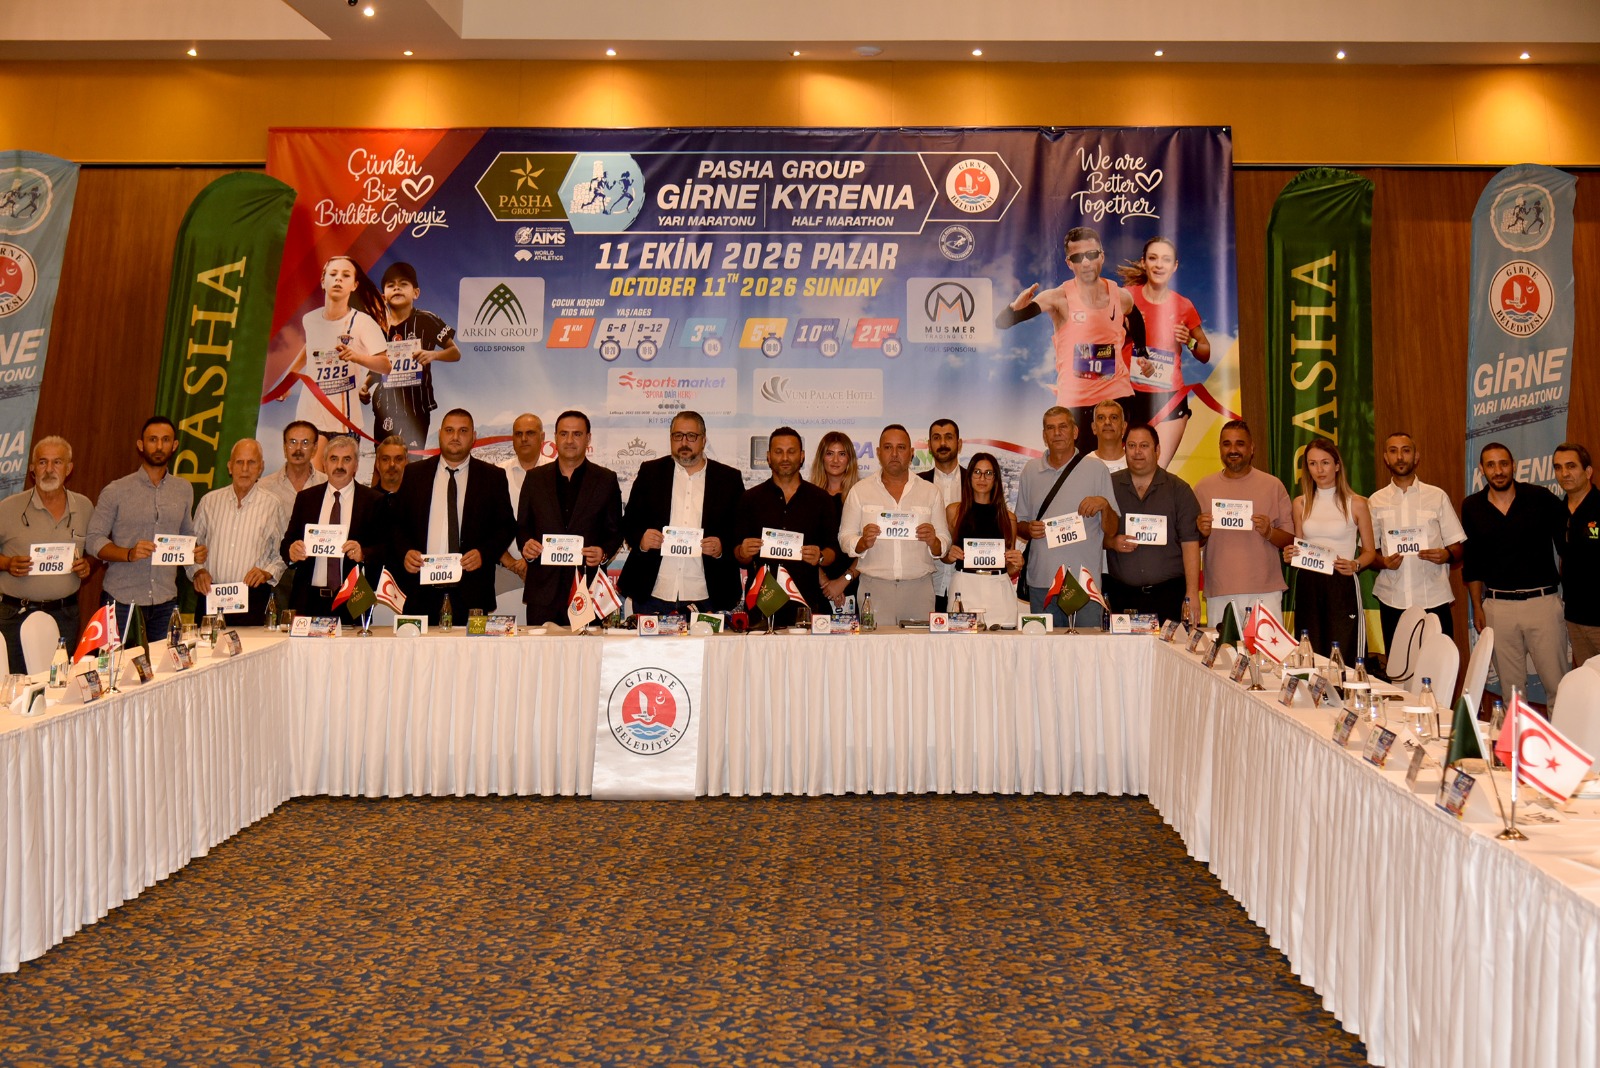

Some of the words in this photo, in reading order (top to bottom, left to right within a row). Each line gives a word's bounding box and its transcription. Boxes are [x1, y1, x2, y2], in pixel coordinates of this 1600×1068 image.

[1076, 144, 1113, 171] We
[1115, 153, 1147, 170] are
[347, 148, 422, 181] Çünkü
[697, 160, 774, 179] PASHA
[782, 160, 865, 179] GROUP
[1086, 171, 1139, 193] Better
[362, 176, 397, 203] Biz
[656, 178, 760, 210] GİRNE
[771, 184, 915, 210] KYRENIA
[498, 195, 553, 208] PASHA
[1070, 190, 1158, 223] Together
[314, 199, 380, 227] Birlikte
[381, 202, 449, 238] Girneyiz
[658, 216, 685, 227] YARI
[687, 216, 756, 227] MARATONU
[791, 216, 823, 227] HALF
[825, 216, 895, 227] MARATHON
[531, 232, 566, 245] AIMS
[594, 242, 630, 270] 11
[638, 237, 714, 270] EKİM
[721, 242, 803, 270] 2026
[810, 242, 899, 270] PAZAR
[1506, 265, 1539, 280] GİRNE
[609, 277, 697, 297] OCTOBER
[740, 277, 798, 297] 2026
[803, 277, 883, 297] SUNDAY
[551, 299, 576, 308] ÇOCUK
[577, 299, 605, 308] KOŞUSU
[462, 328, 497, 337] ARKIN
[500, 328, 539, 337] GROUP
[390, 358, 419, 372] 403
[1088, 360, 1102, 373] 10
[173, 256, 247, 489] PASHA
[316, 364, 349, 381] 7325
[1473, 347, 1568, 398] GİRNE
[636, 377, 727, 390] sportsmarket
[785, 390, 807, 399] VUNI
[809, 390, 844, 399] PALACE
[846, 390, 875, 399] HOTEL
[1473, 400, 1498, 417] YARI
[1500, 386, 1563, 411] MARATONU
[1221, 517, 1244, 528] 0020
[886, 527, 909, 538] 0022
[1056, 531, 1078, 544] 1905
[1135, 532, 1158, 542] 0007
[312, 544, 336, 555] 0542
[670, 544, 693, 555] 0001
[769, 546, 793, 557] 0003
[1397, 542, 1420, 553] 0040
[161, 552, 185, 563] 0015
[551, 552, 574, 563] 0002
[973, 556, 996, 566] 0008
[1301, 556, 1325, 570] 0005
[39, 562, 64, 572] 0058
[429, 571, 453, 581] 0004
[624, 671, 677, 690] GİRNE
[614, 725, 681, 751] BELEDİYESİ
